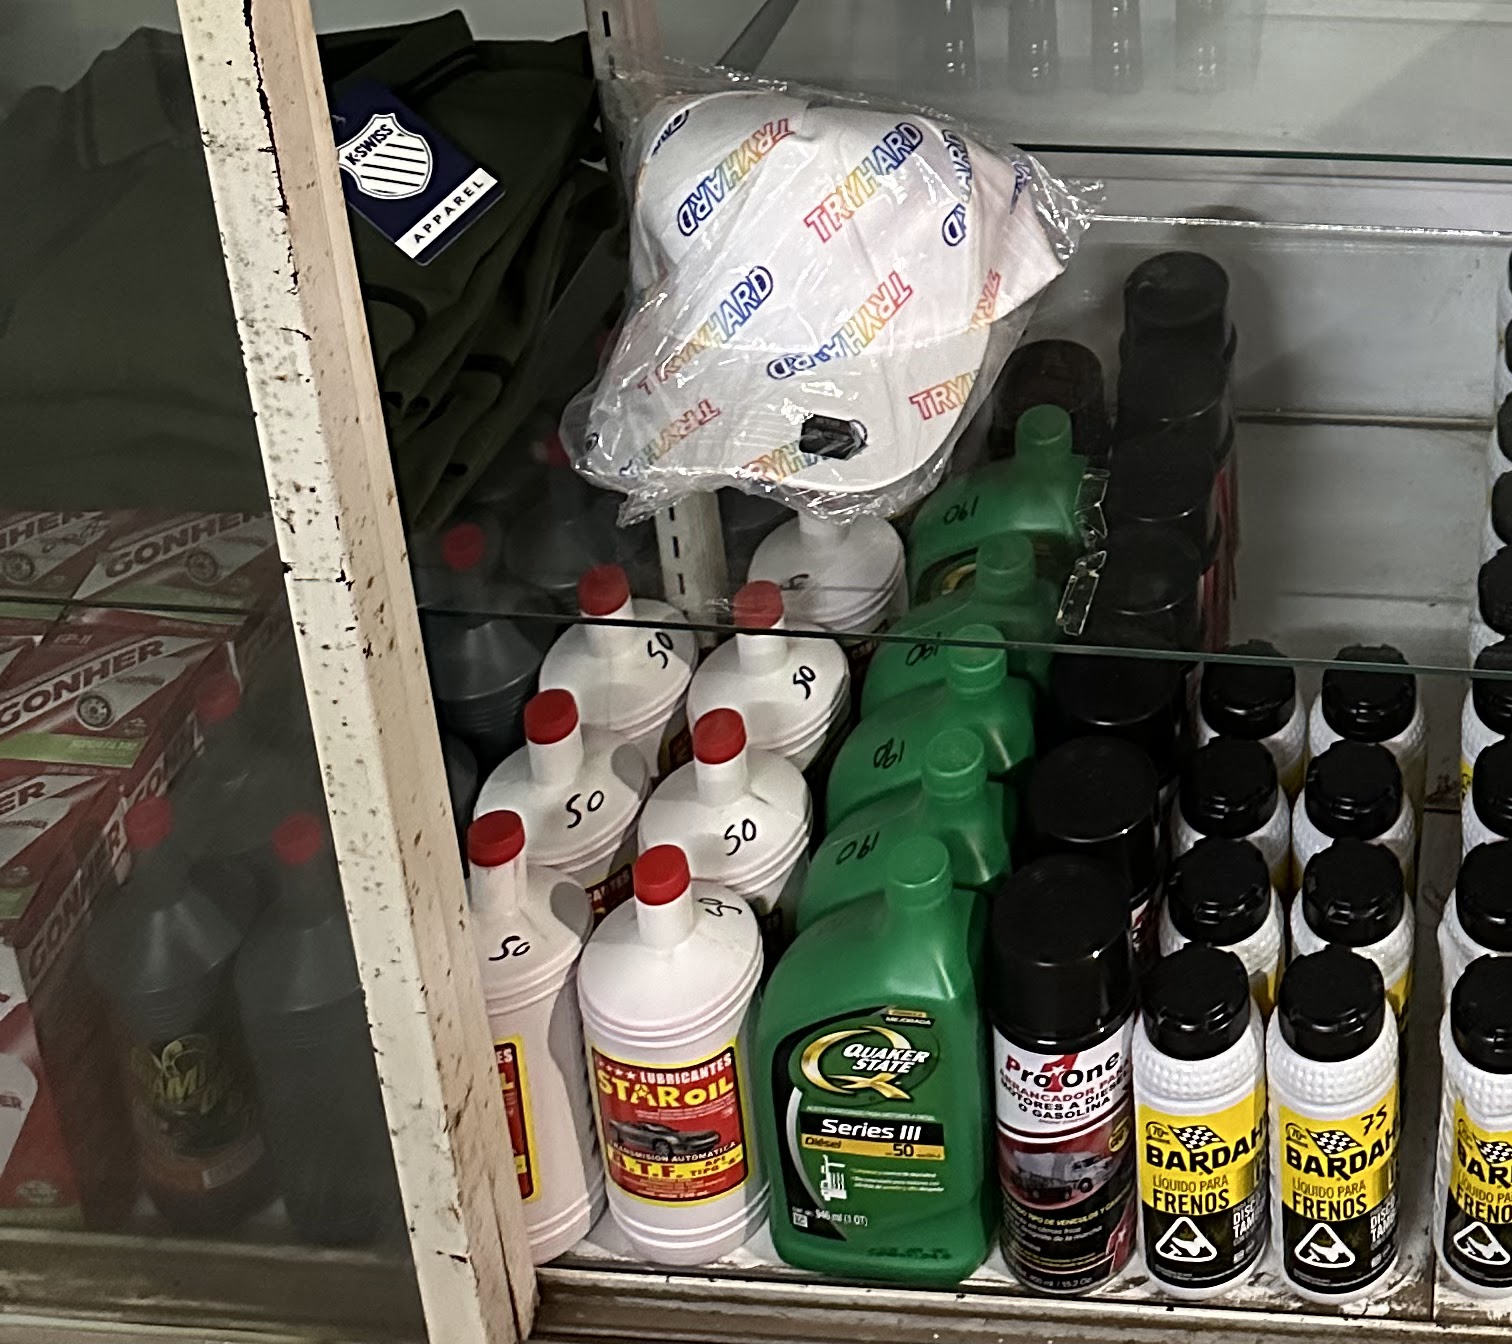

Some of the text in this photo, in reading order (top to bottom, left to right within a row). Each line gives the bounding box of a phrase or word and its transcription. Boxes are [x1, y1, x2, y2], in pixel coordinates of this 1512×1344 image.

[803, 122, 923, 243] TRYHARD
[413, 178, 485, 244] APPAREL
[647, 631, 675, 669] 50
[792, 665, 818, 700] 50
[565, 790, 605, 829] 50
[723, 818, 758, 857] 50
[488, 935, 531, 962] 50
[842, 1043, 931, 1064] QUAKER
[852, 1057, 917, 1074] STATE
[639, 1052, 733, 1085] LUBRICANTES
[1031, 1096, 1112, 1121] GASOLINA
[1069, 1100, 1079, 1111] A
[820, 1118, 922, 1141] Series III
[1360, 1104, 1388, 1137] 75
[892, 1143, 915, 1158] 50
[1152, 1174, 1229, 1195] LÍQUIDO PARA
[1291, 1179, 1367, 1199] LÍQUIDO PARA
[1152, 1188, 1230, 1216] FRENOS
[1291, 1193, 1368, 1222] FRENOS
